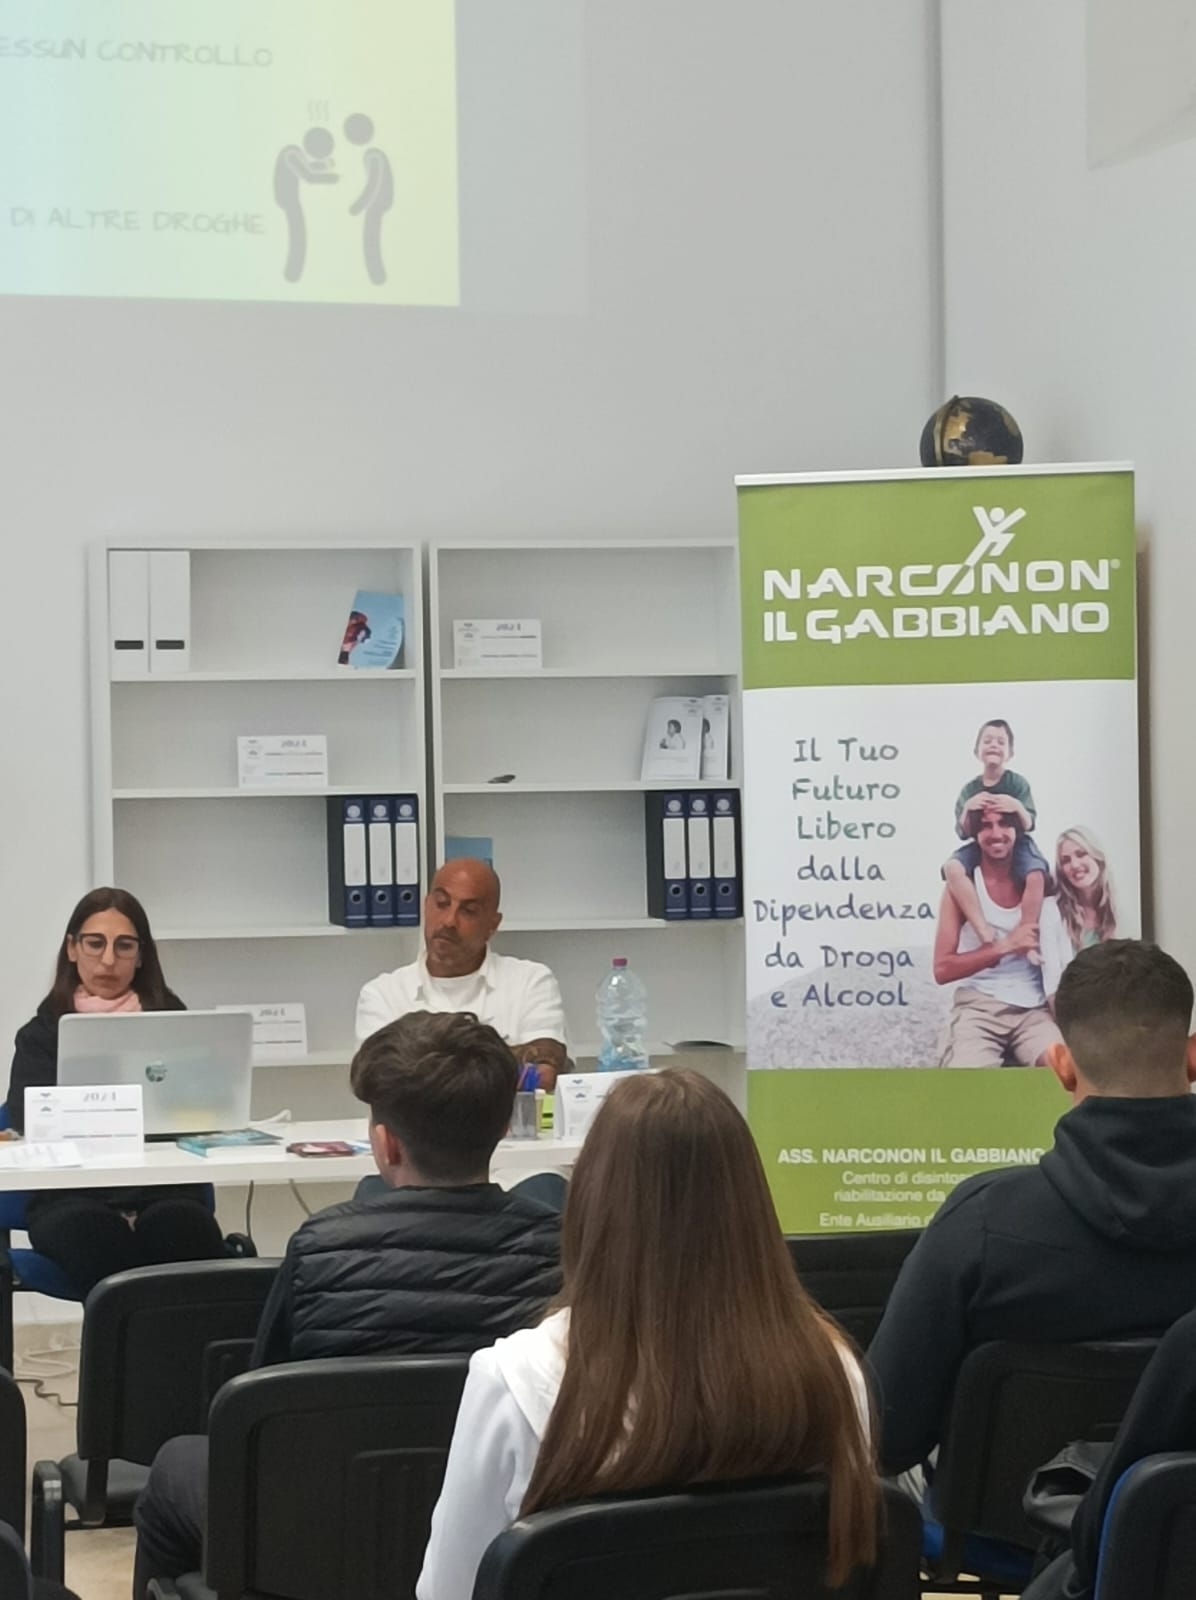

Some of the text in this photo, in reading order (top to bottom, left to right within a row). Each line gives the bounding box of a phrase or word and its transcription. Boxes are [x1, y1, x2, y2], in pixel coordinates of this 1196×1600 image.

[96, 40, 273, 67] CONTROLLO
[10, 206, 266, 235] DI ALTRE DROGHE
[763, 603, 1109, 643] IL GABBIANO
[793, 737, 899, 763] Il Tuo
[792, 776, 901, 801] Futuro
[797, 811, 896, 841] Libero
[797, 854, 886, 881] dalla
[753, 893, 935, 936] Dipendenza
[765, 942, 913, 977] da Droga
[771, 981, 908, 1008] e Alcool
[778, 1149, 817, 1164] ASS.
[822, 1149, 926, 1164] NARCONON
[931, 1149, 947, 1164] IL
[843, 1171, 891, 1185] Centro
[894, 1171, 908, 1185] di
[834, 1189, 946, 1203] riabilitazione da
[819, 1213, 852, 1227] Ente
[856, 1212, 920, 1228] Ausiliario
